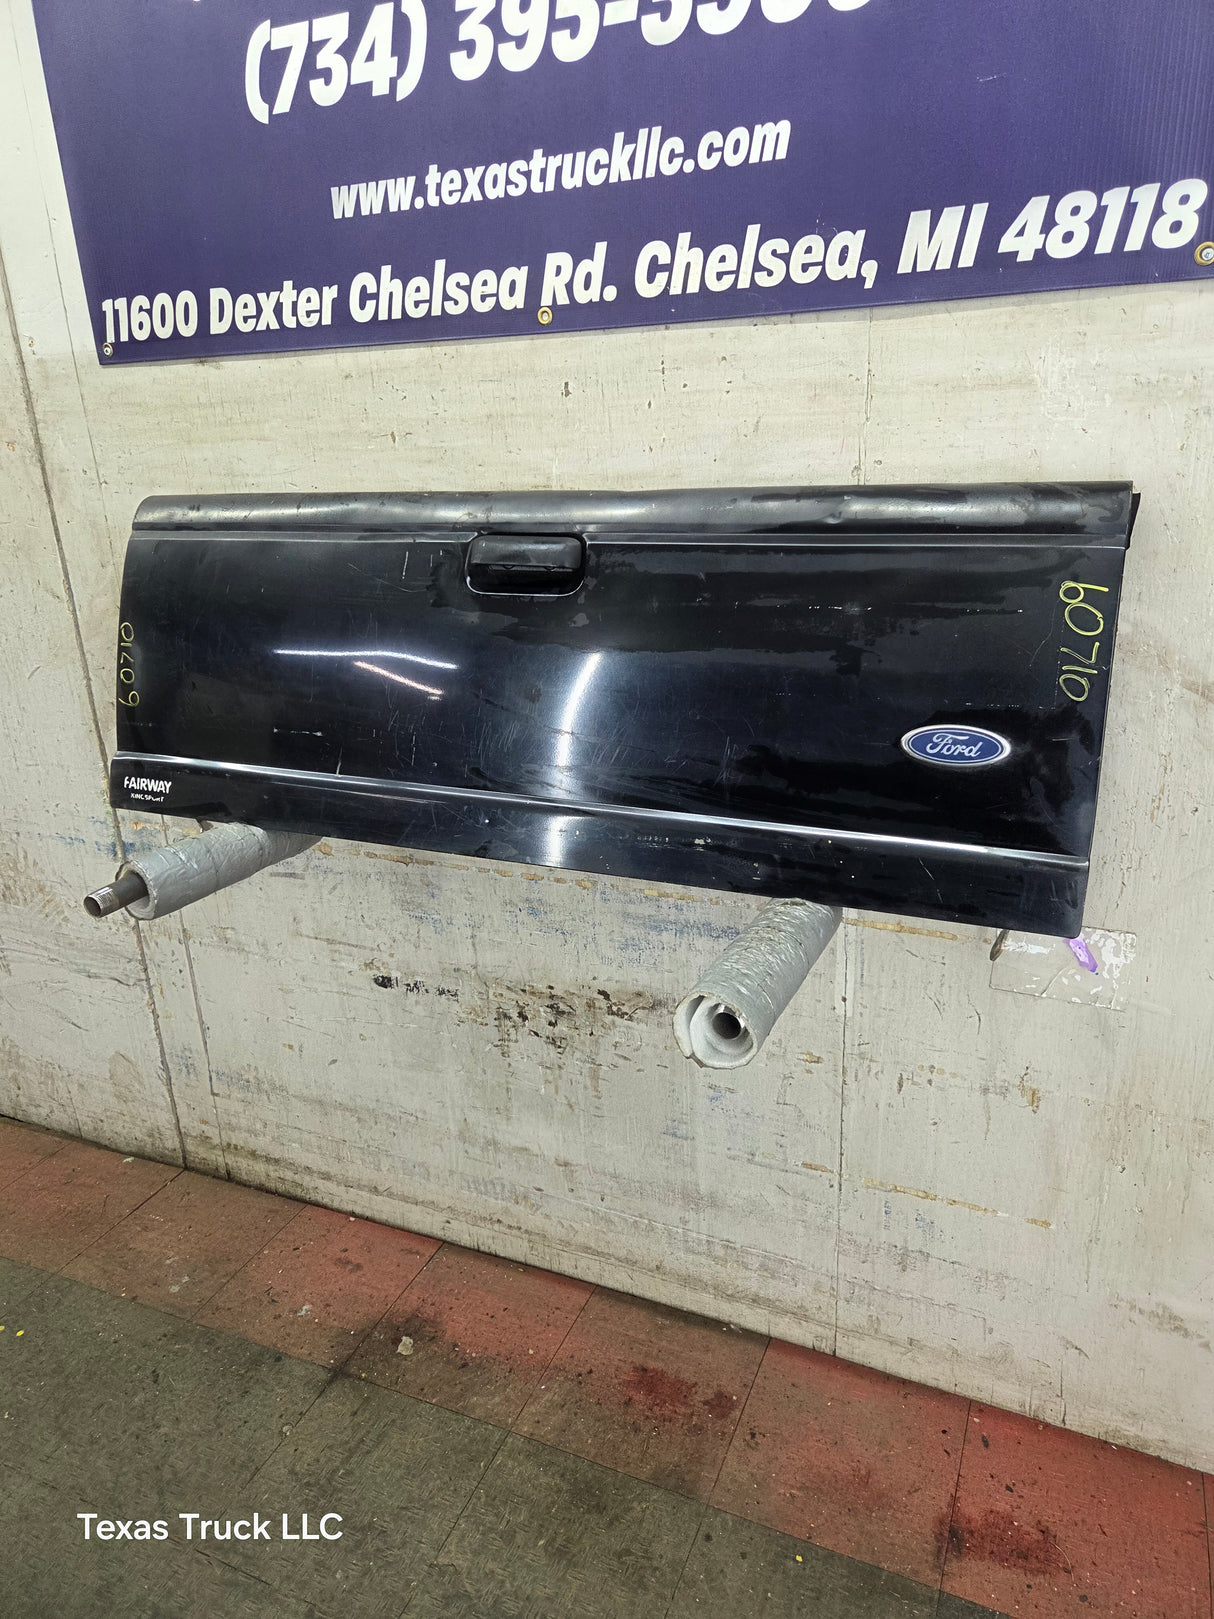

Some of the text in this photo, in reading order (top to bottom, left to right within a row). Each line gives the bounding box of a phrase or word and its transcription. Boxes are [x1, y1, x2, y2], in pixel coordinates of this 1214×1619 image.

[245, 0, 427, 124] (734)
[331, 119, 792, 220] www.texastruckllc.com
[102, 178, 1209, 343] 11600 Dexter Chelsea Rd. Chelsea, MI 48118
[118, 621, 140, 707] 60710
[1059, 580, 1109, 701] 60710
[123, 776, 172, 794] FAIRWAY
[925, 732, 983, 758] Ford
